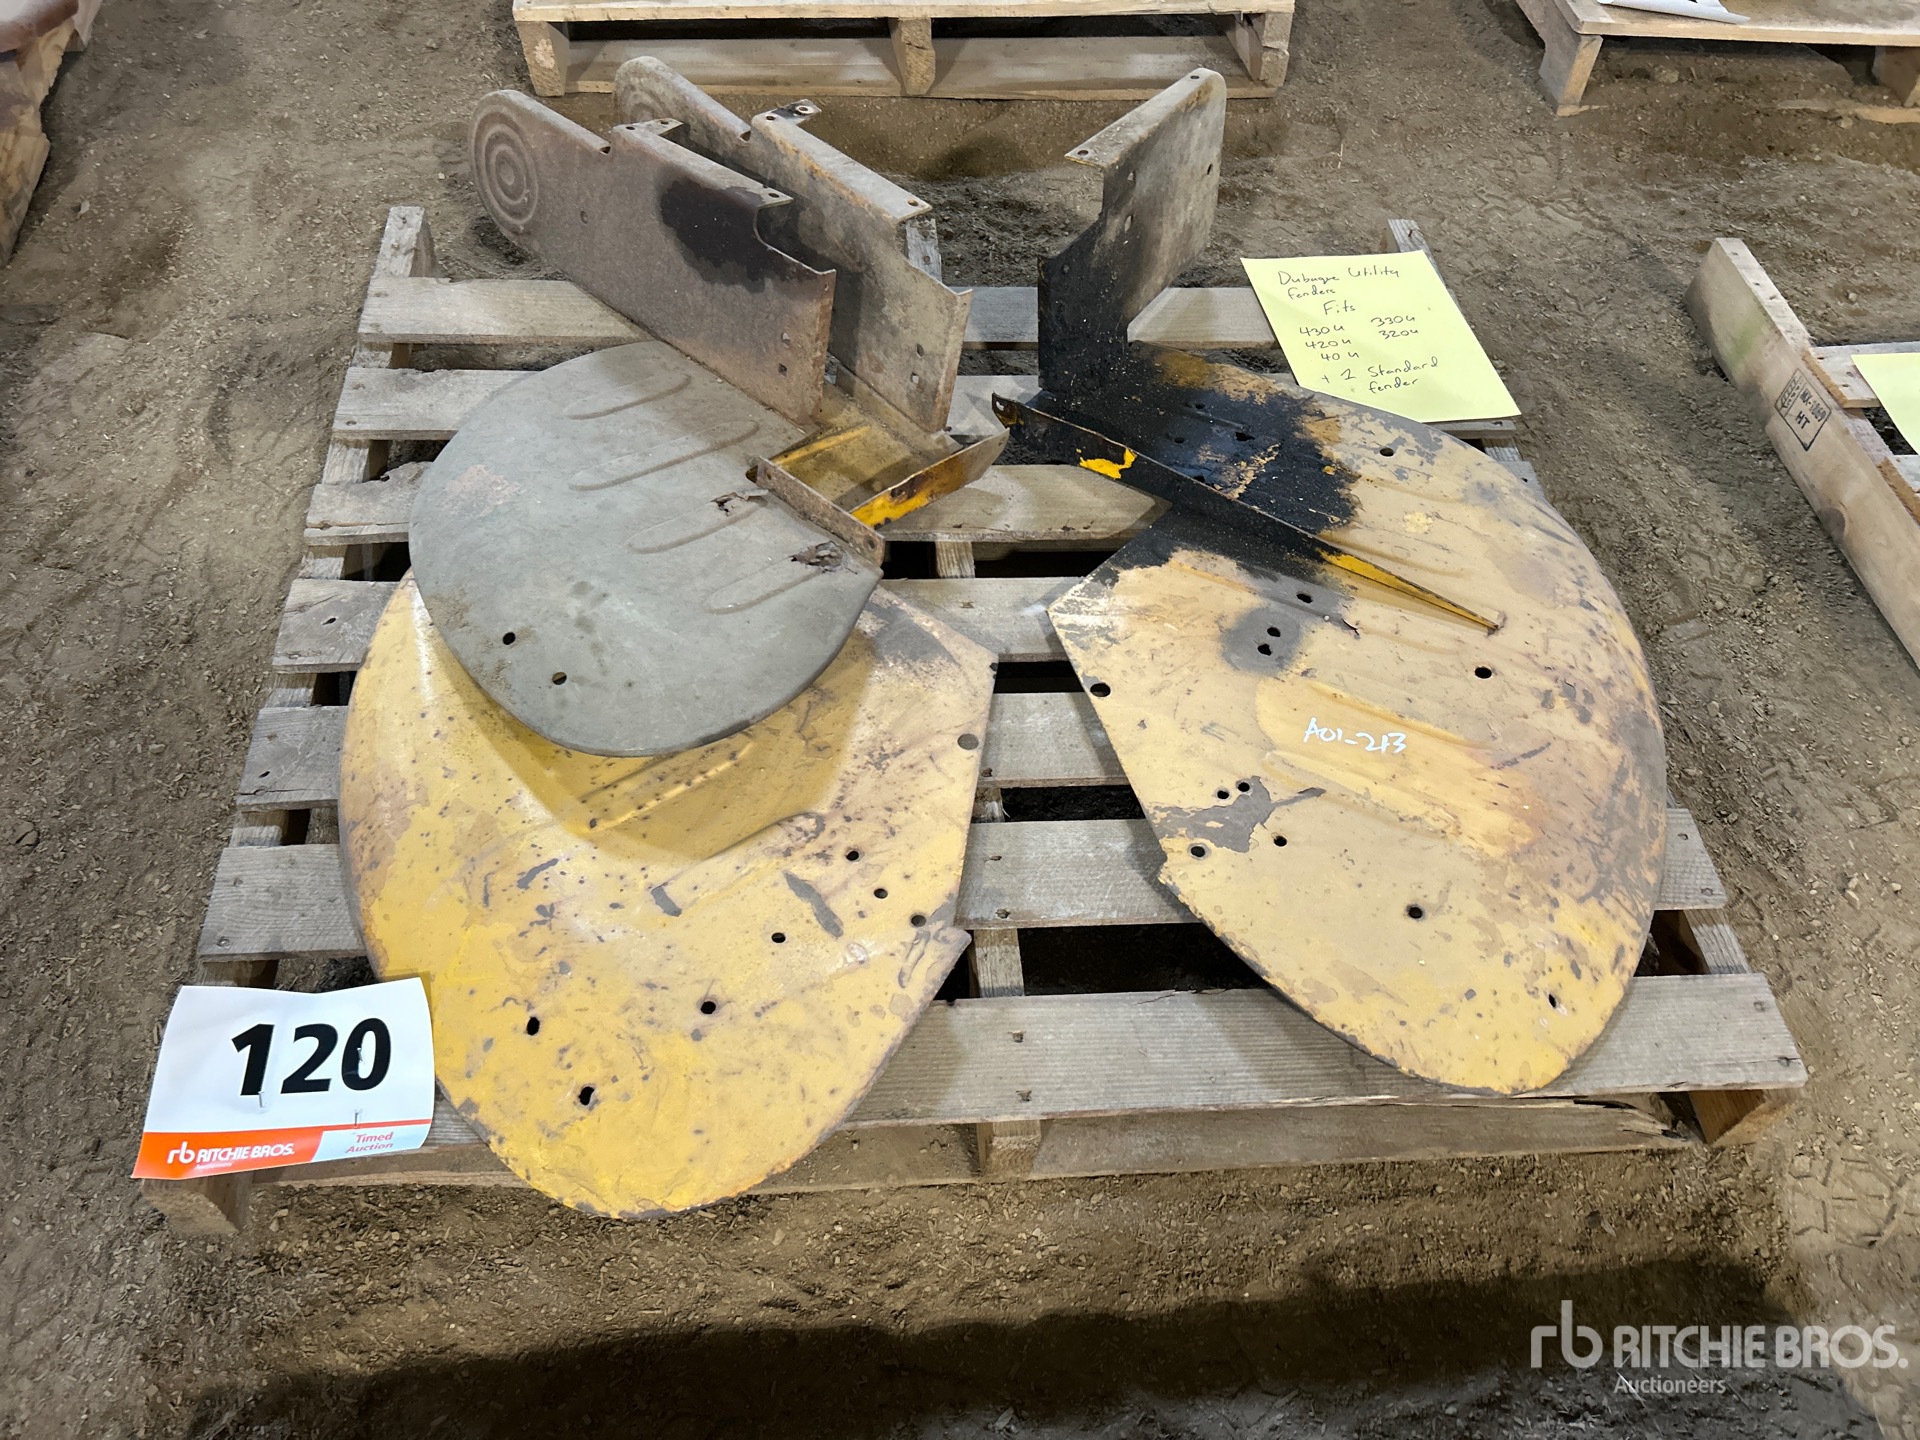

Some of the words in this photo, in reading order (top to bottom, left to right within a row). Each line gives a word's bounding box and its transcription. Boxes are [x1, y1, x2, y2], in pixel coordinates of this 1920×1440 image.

[1278, 271, 1340, 285] Dubuque
[1347, 265, 1399, 277] Utility
[1323, 299, 1356, 315] Fits
[1795, 411, 1811, 429] HT
[231, 1017, 392, 1097] 120
[356, 1131, 394, 1143] Timed
[167, 1142, 195, 1164] rb
[196, 1147, 250, 1163] RITCHIE
[251, 1144, 295, 1158] BROS.
[344, 1143, 393, 1153] Auction
